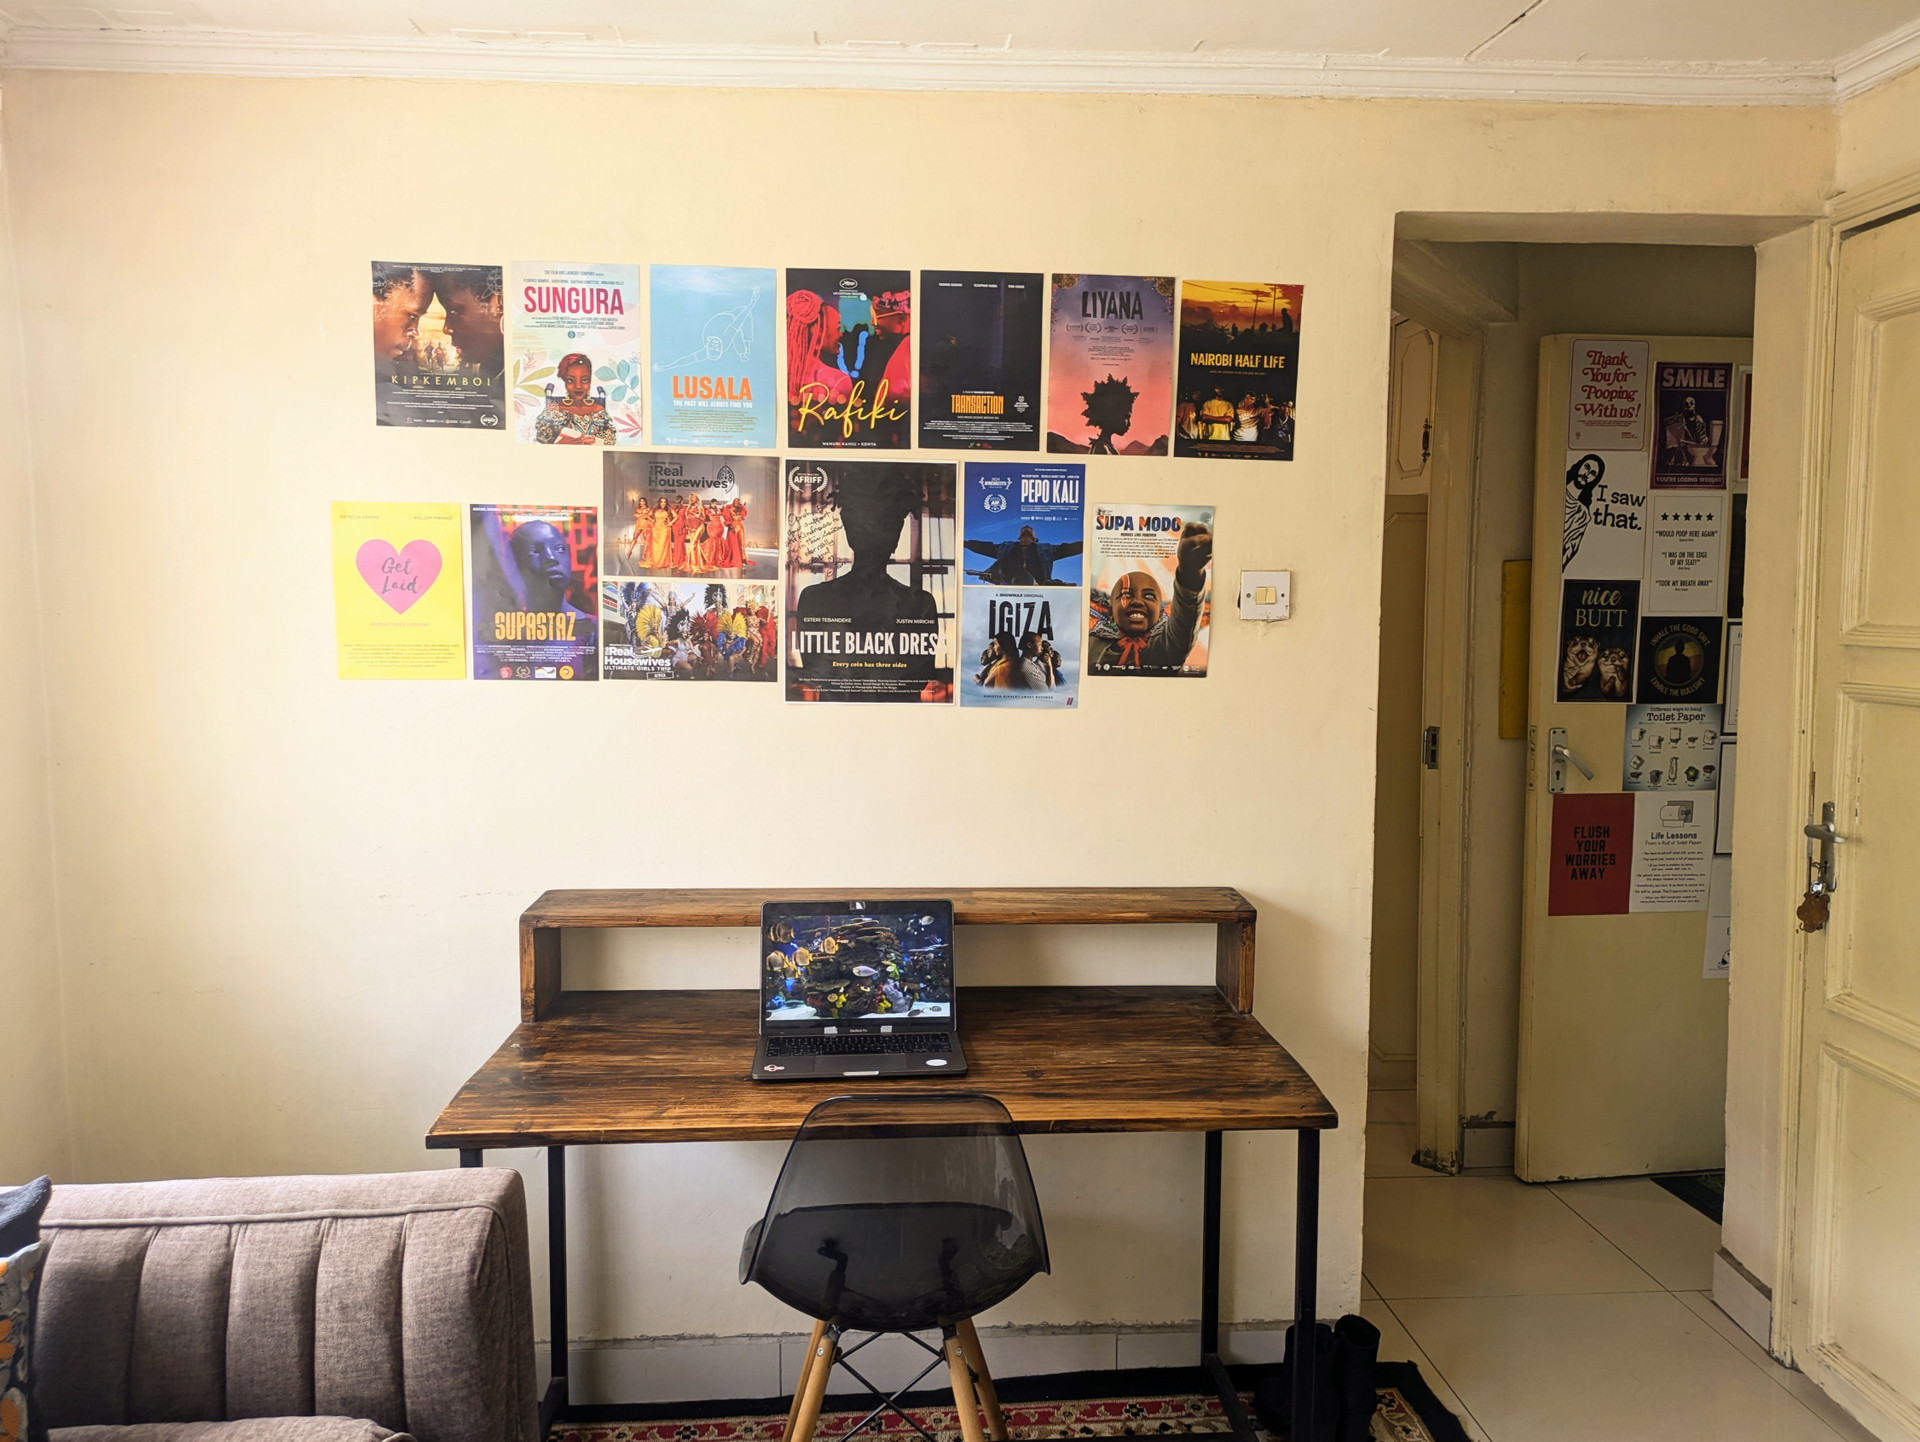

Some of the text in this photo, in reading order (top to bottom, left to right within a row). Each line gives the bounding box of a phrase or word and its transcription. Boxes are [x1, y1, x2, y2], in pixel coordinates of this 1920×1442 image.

[524, 286, 624, 315] SUNGURA
[1082, 291, 1143, 320] LIYANA
[1190, 352, 1285, 368] NAIROBI HALF LIFE
[1587, 350, 1633, 369] Thank
[392, 375, 490, 386] KIPKEMBOI
[1583, 368, 1636, 386] You for
[1662, 368, 1724, 388] SMILE
[673, 376, 752, 400] LUSALA
[1582, 385, 1638, 402] Pooping
[798, 379, 908, 438] Rafiki
[951, 395, 1004, 414] TRANSACTION
[1575, 403, 1641, 418] With us!
[654, 465, 683, 476] Real
[648, 476, 728, 488] Housewives
[1021, 479, 1050, 503] PEPO
[1052, 480, 1079, 503] KALI
[1596, 484, 1646, 507] I saw
[1096, 515, 1134, 531] SUPA
[1139, 517, 1181, 532] MODO
[1593, 504, 1642, 530] that.
[382, 557, 414, 575] Get
[382, 576, 420, 594] Laid
[1581, 586, 1621, 606] nice
[494, 611, 576, 640] SUPASTAZ
[989, 600, 1054, 640] IGIZA
[1575, 608, 1627, 627] BUTT
[792, 631, 840, 654] LITTLE
[845, 632, 894, 655] BLACK
[1650, 627, 1668, 647] INHALE
[1682, 624, 1699, 635] GOOD
[1698, 632, 1711, 646] SHIT
[610, 647, 633, 656] Real
[605, 656, 671, 666] Housewives
[1680, 677, 1706, 696] BULLSHIT
[1647, 713, 1706, 722] Toilet Paper
[1574, 826, 1610, 838] FLUSH
[1576, 840, 1606, 852] YOUR
[1565, 854, 1616, 866] WORRIES
[1570, 868, 1606, 880] AWAY
